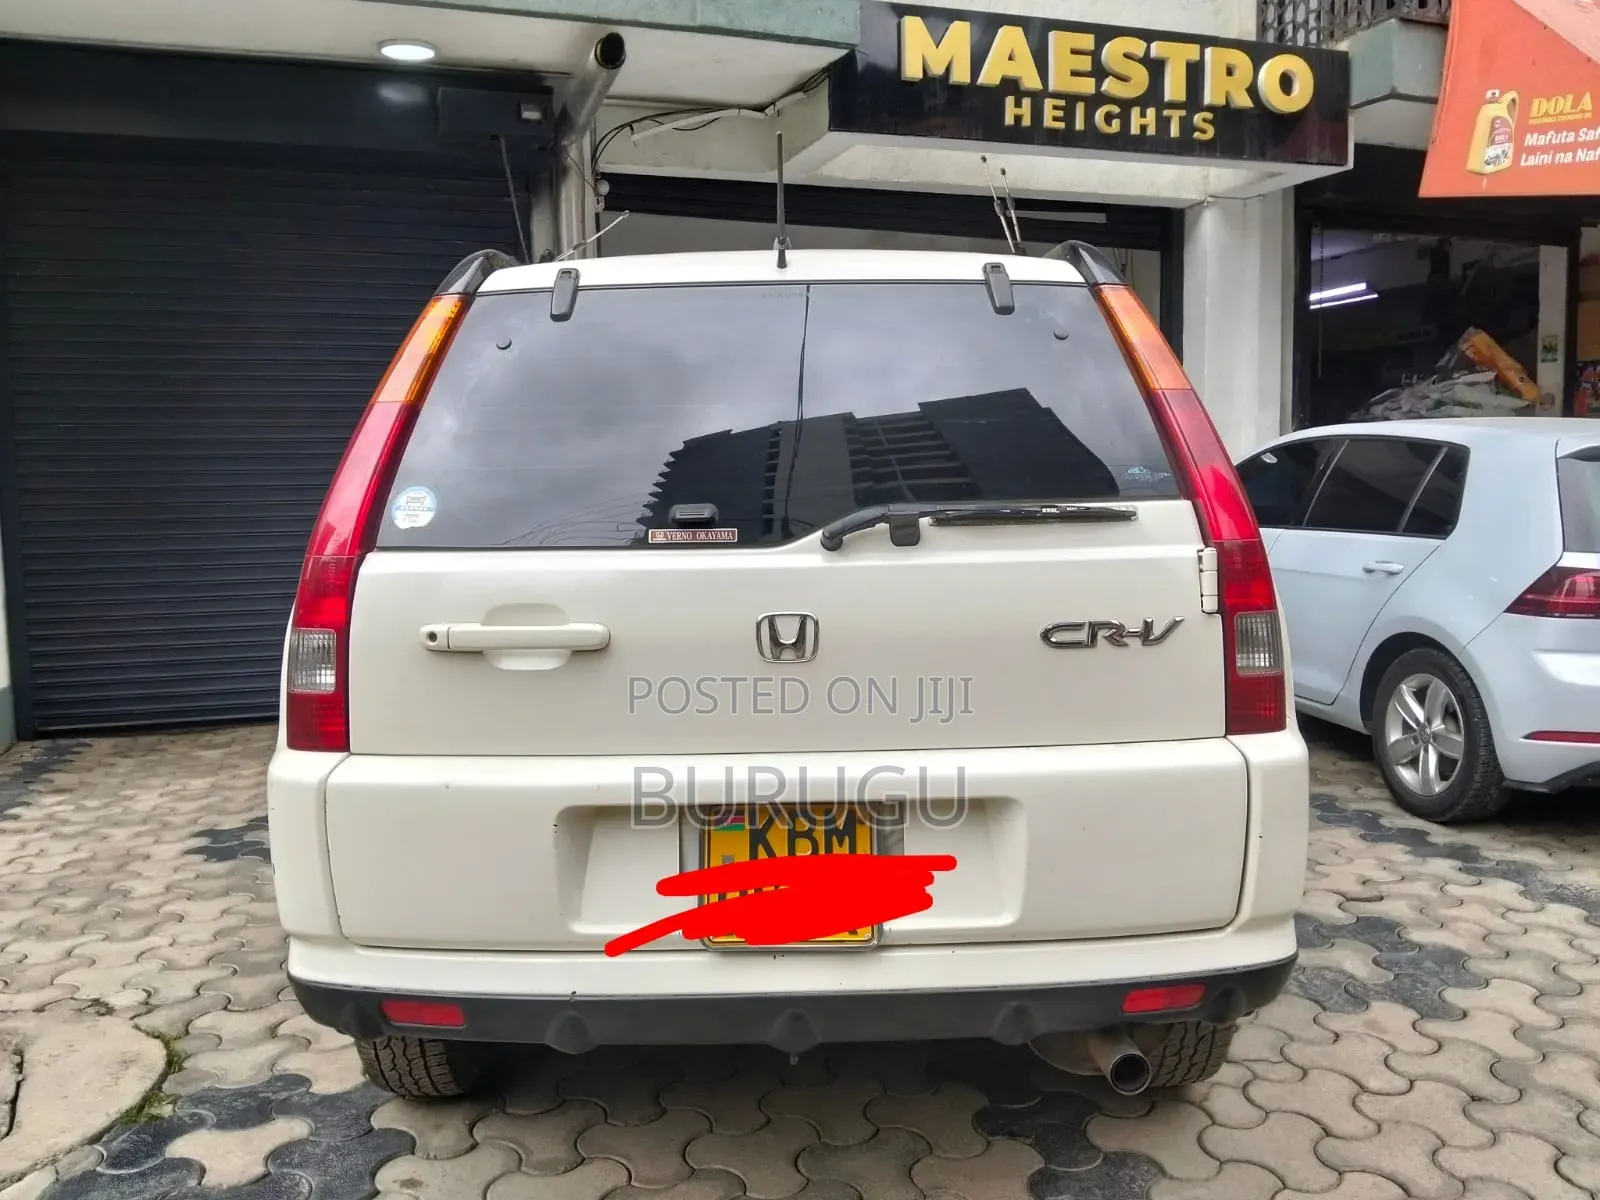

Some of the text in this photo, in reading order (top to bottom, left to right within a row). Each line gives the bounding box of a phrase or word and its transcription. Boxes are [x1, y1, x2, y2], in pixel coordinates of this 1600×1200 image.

[900, 15, 1314, 115] MAESTRO
[1529, 91, 1593, 117] DOLA
[1004, 95, 1215, 141] HEIGHTS
[1524, 130, 1575, 147] Mafuta
[1520, 150, 1554, 166] Laini
[1555, 152, 1573, 164] na
[667, 531, 733, 541] VERNO OKAYAMA
[1040, 616, 1185, 648] CR-V
